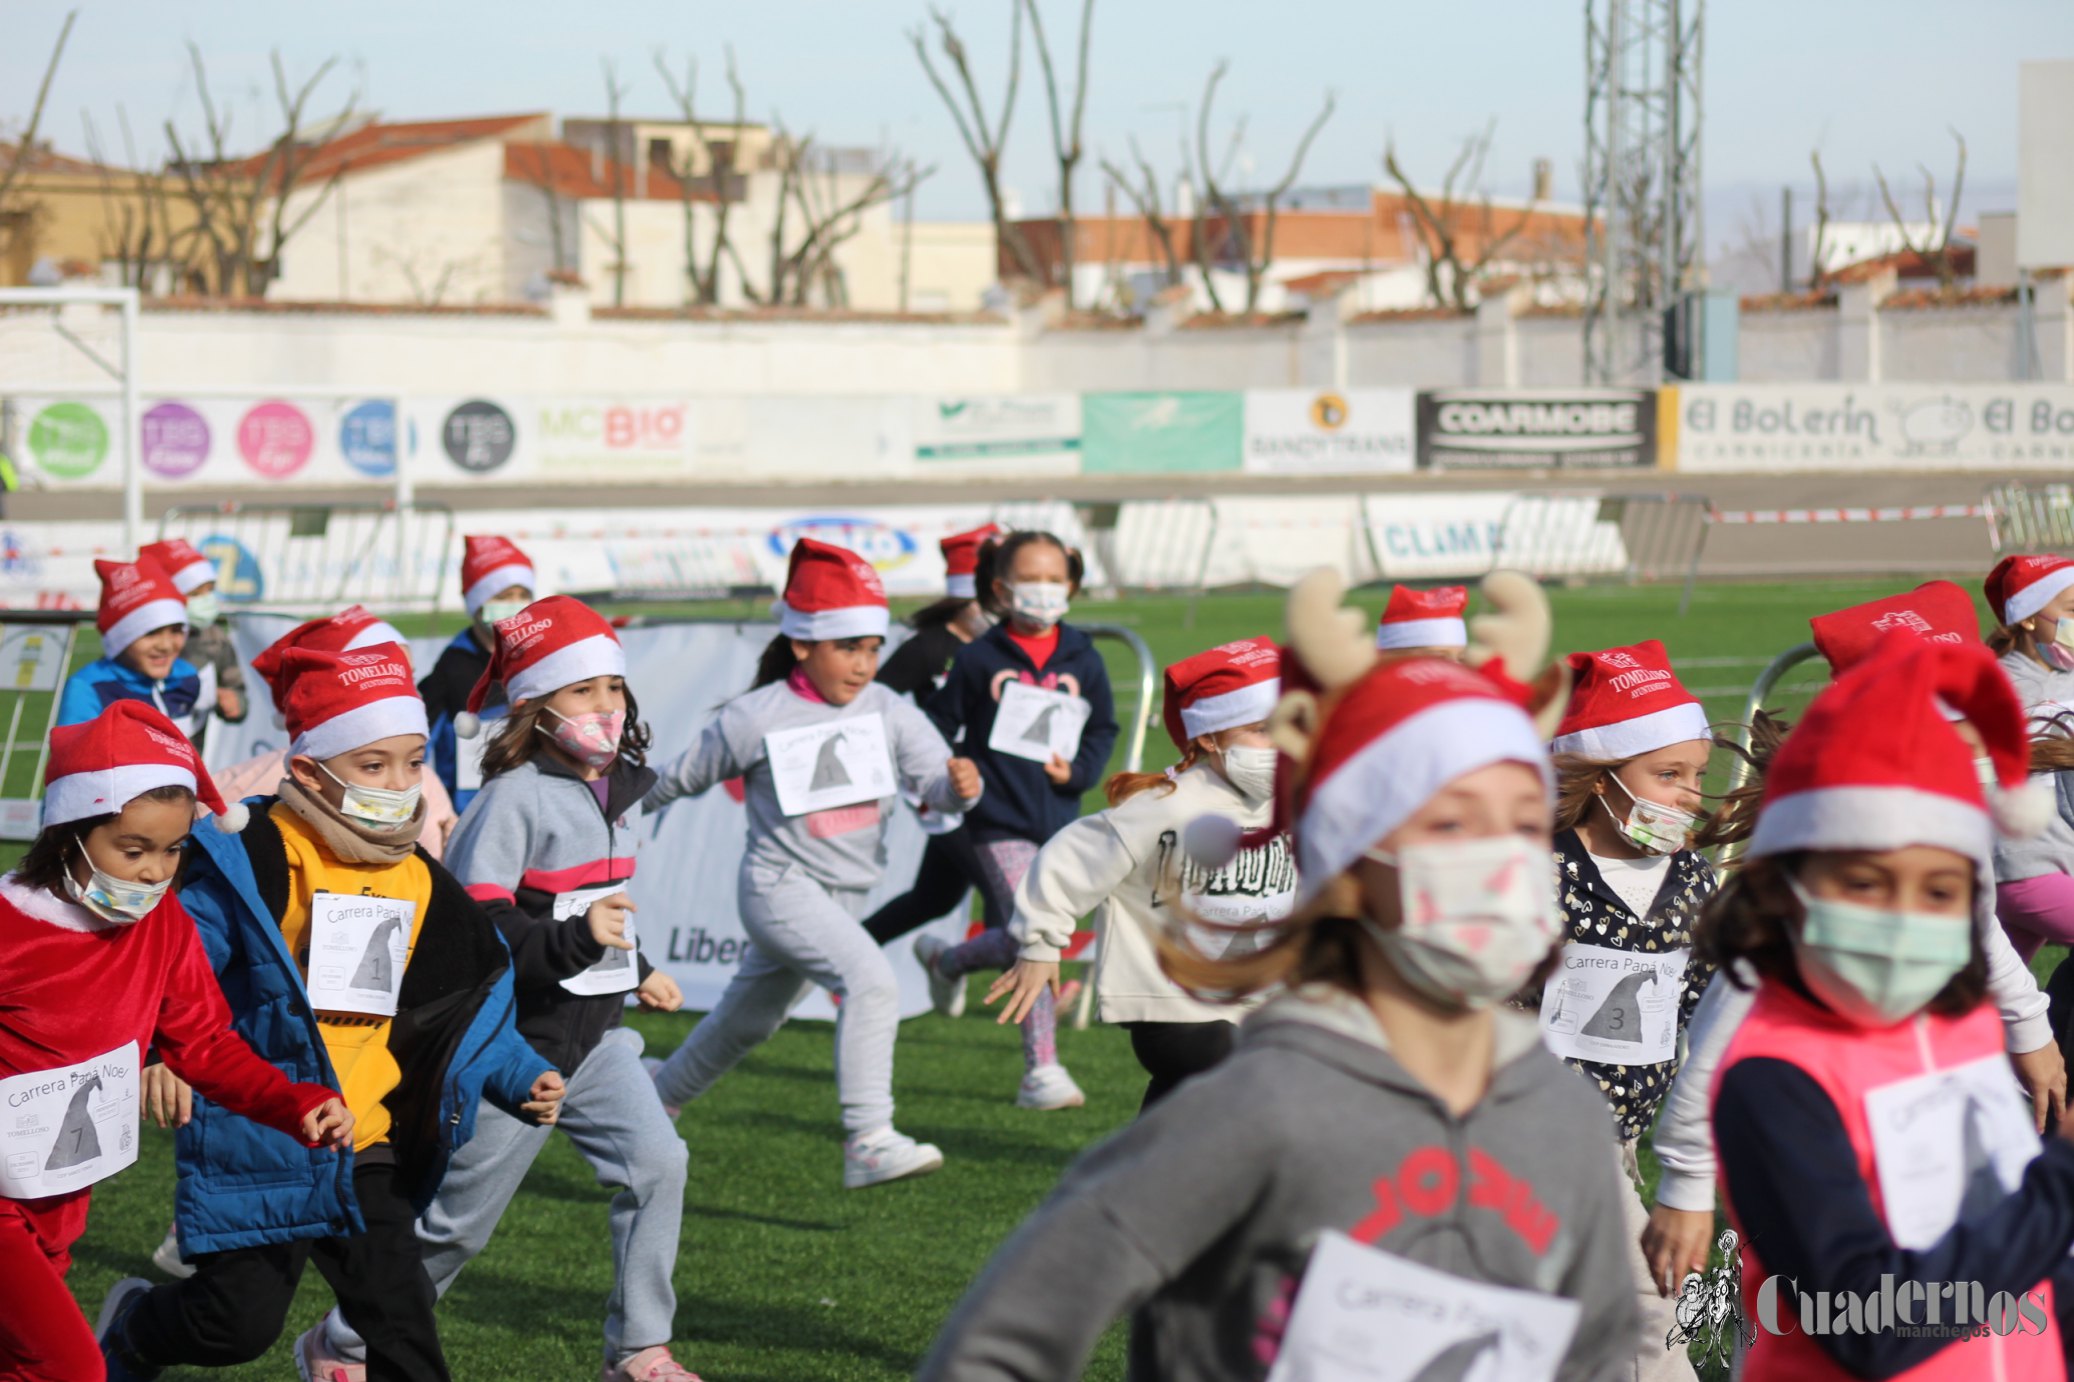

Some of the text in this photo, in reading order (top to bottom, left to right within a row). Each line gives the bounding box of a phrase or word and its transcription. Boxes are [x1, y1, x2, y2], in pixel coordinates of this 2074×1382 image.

[1685, 398, 1717, 433] El
[1983, 398, 2015, 434] El
[1609, 669, 1672, 693] TOMELLOSO
[327, 906, 373, 924] Carrera
[371, 957, 382, 981] 1
[1565, 957, 1619, 970] Carrera
[1623, 957, 1658, 974] Papá
[1608, 1008, 1626, 1031] 3
[8, 1063, 129, 1108] Carrera Papá Noel
[70, 1127, 83, 1154] 7
